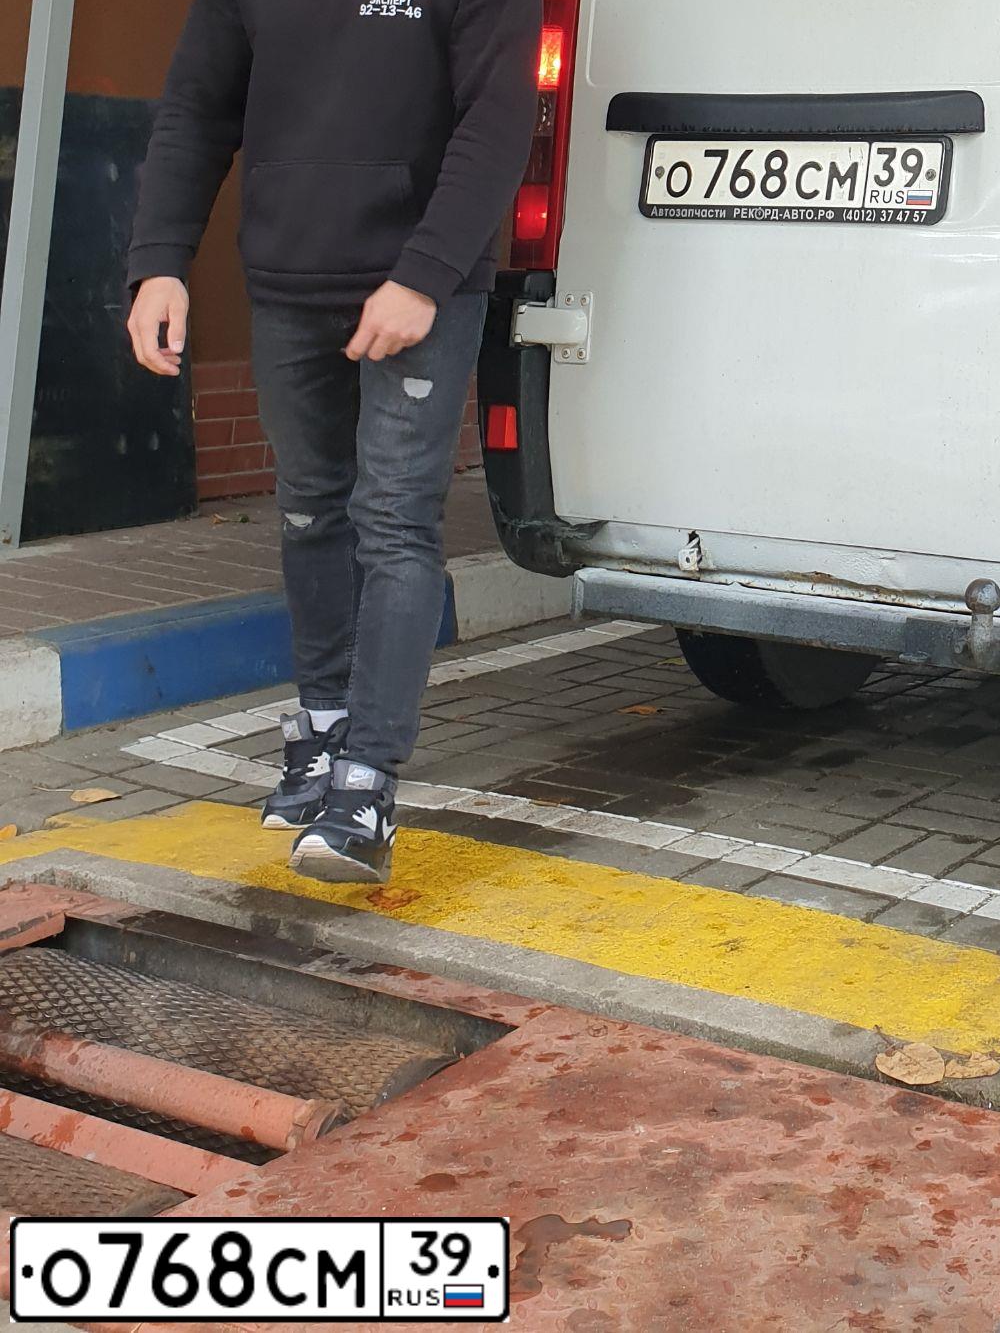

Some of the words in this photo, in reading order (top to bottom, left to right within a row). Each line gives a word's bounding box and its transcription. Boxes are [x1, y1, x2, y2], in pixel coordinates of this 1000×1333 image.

[359, 4, 422, 19] 92-13-46
[873, 147, 924, 188] 39
[869, 190, 905, 205] RUS
[650, 205, 727, 219] Автозапчасти
[733, 207, 835, 221] РЕКОРД-АВТО.РФ
[842, 208, 877, 222] (4012)
[879, 210, 894, 222] 37
[896, 210, 911, 223] 47
[912, 210, 927, 223] 57
